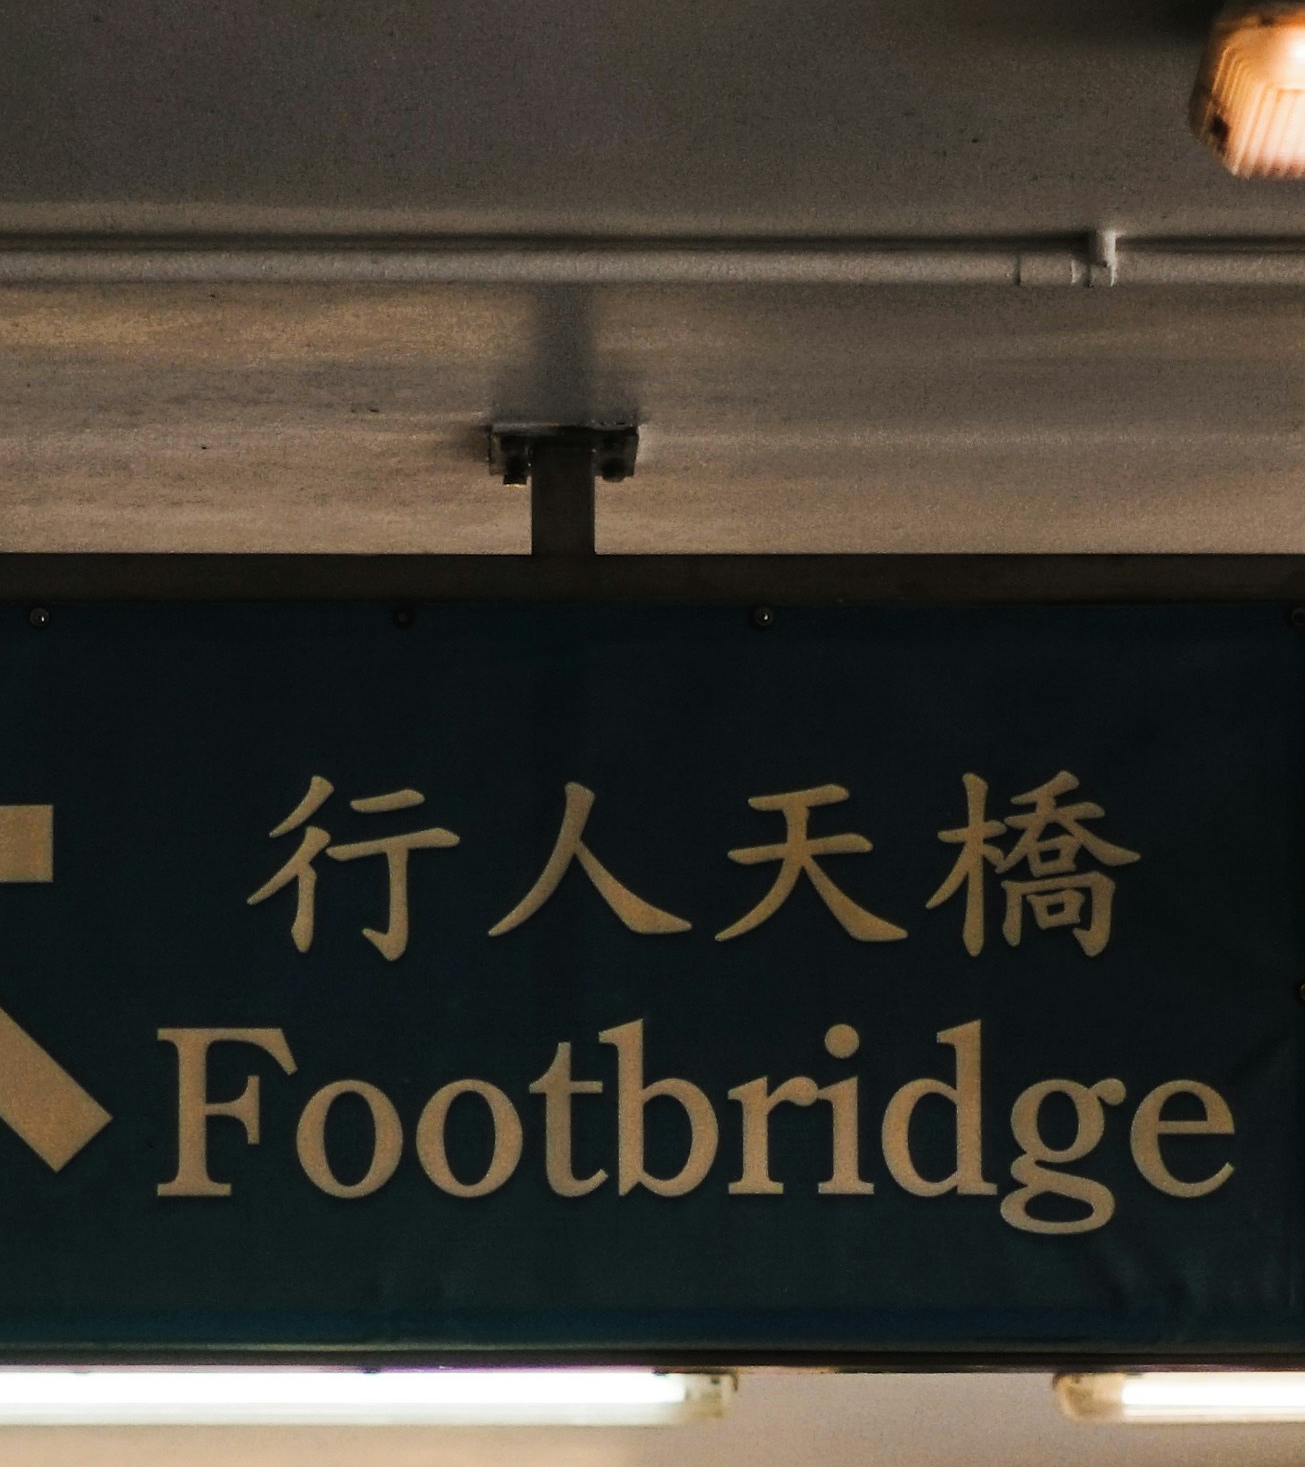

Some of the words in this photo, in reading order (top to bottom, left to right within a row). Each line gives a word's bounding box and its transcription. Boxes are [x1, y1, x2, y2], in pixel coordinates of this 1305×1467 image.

[246, 769, 1141, 963] 行人天橋
[155, 1017, 1238, 1234] Footbridge
